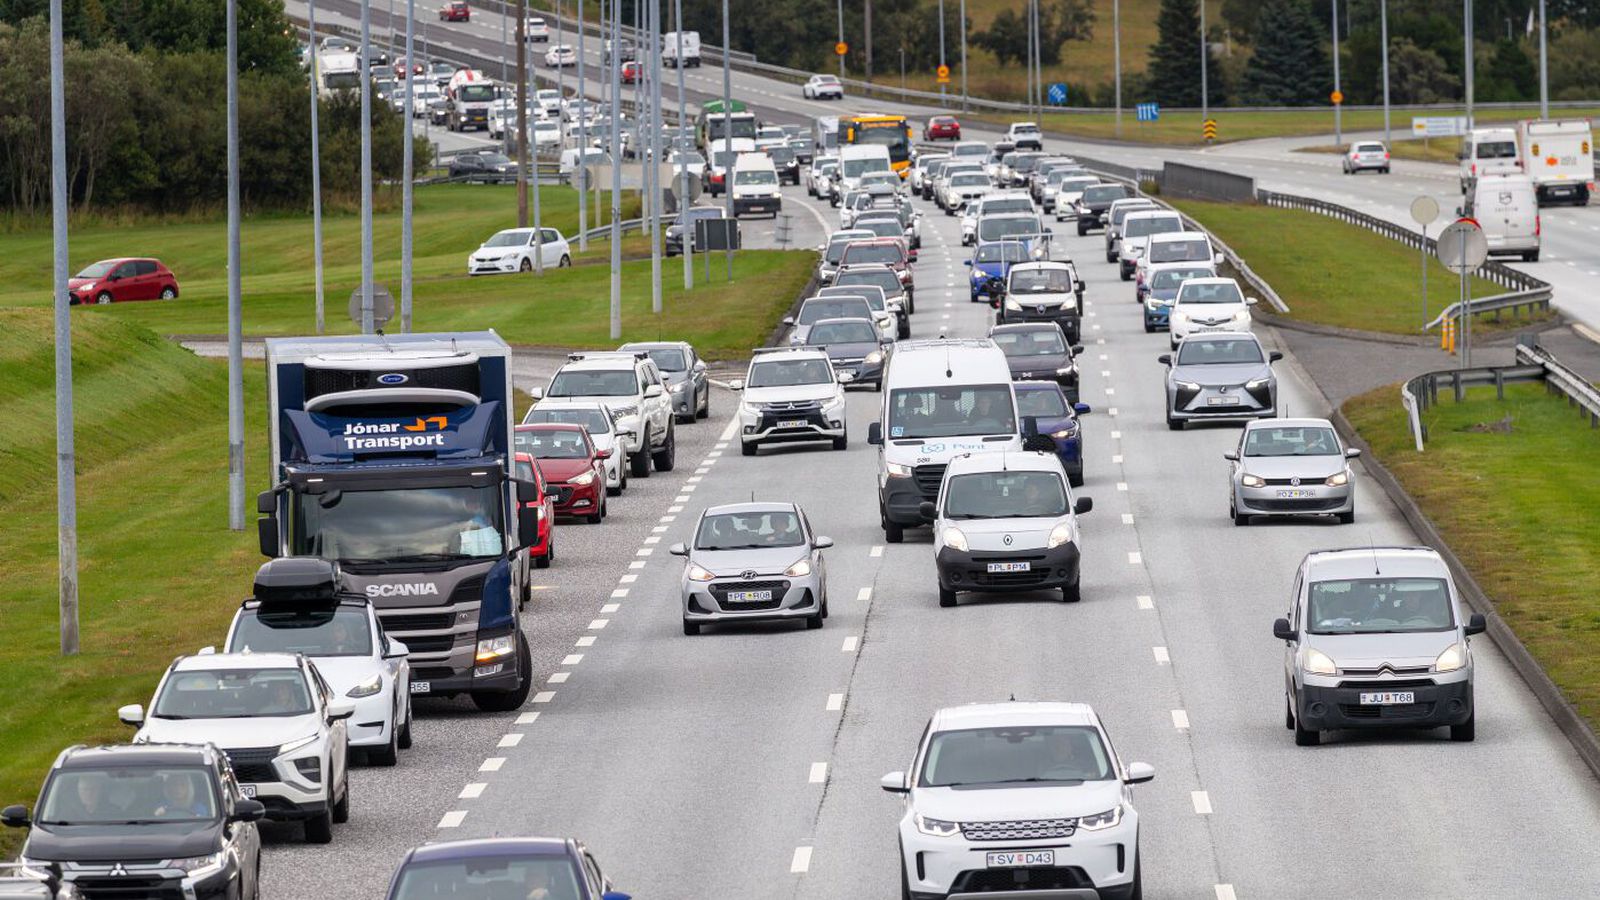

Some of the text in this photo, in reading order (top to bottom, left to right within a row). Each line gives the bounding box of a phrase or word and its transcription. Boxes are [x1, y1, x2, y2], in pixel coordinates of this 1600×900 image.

[343, 422, 400, 435] Jónar
[344, 433, 444, 449] Transport
[994, 562, 1027, 571] PL P14
[366, 582, 439, 598] SCANIA
[735, 592, 746, 601] PE
[1370, 693, 1413, 703] JU T68
[997, 852, 1052, 865] SV D43
